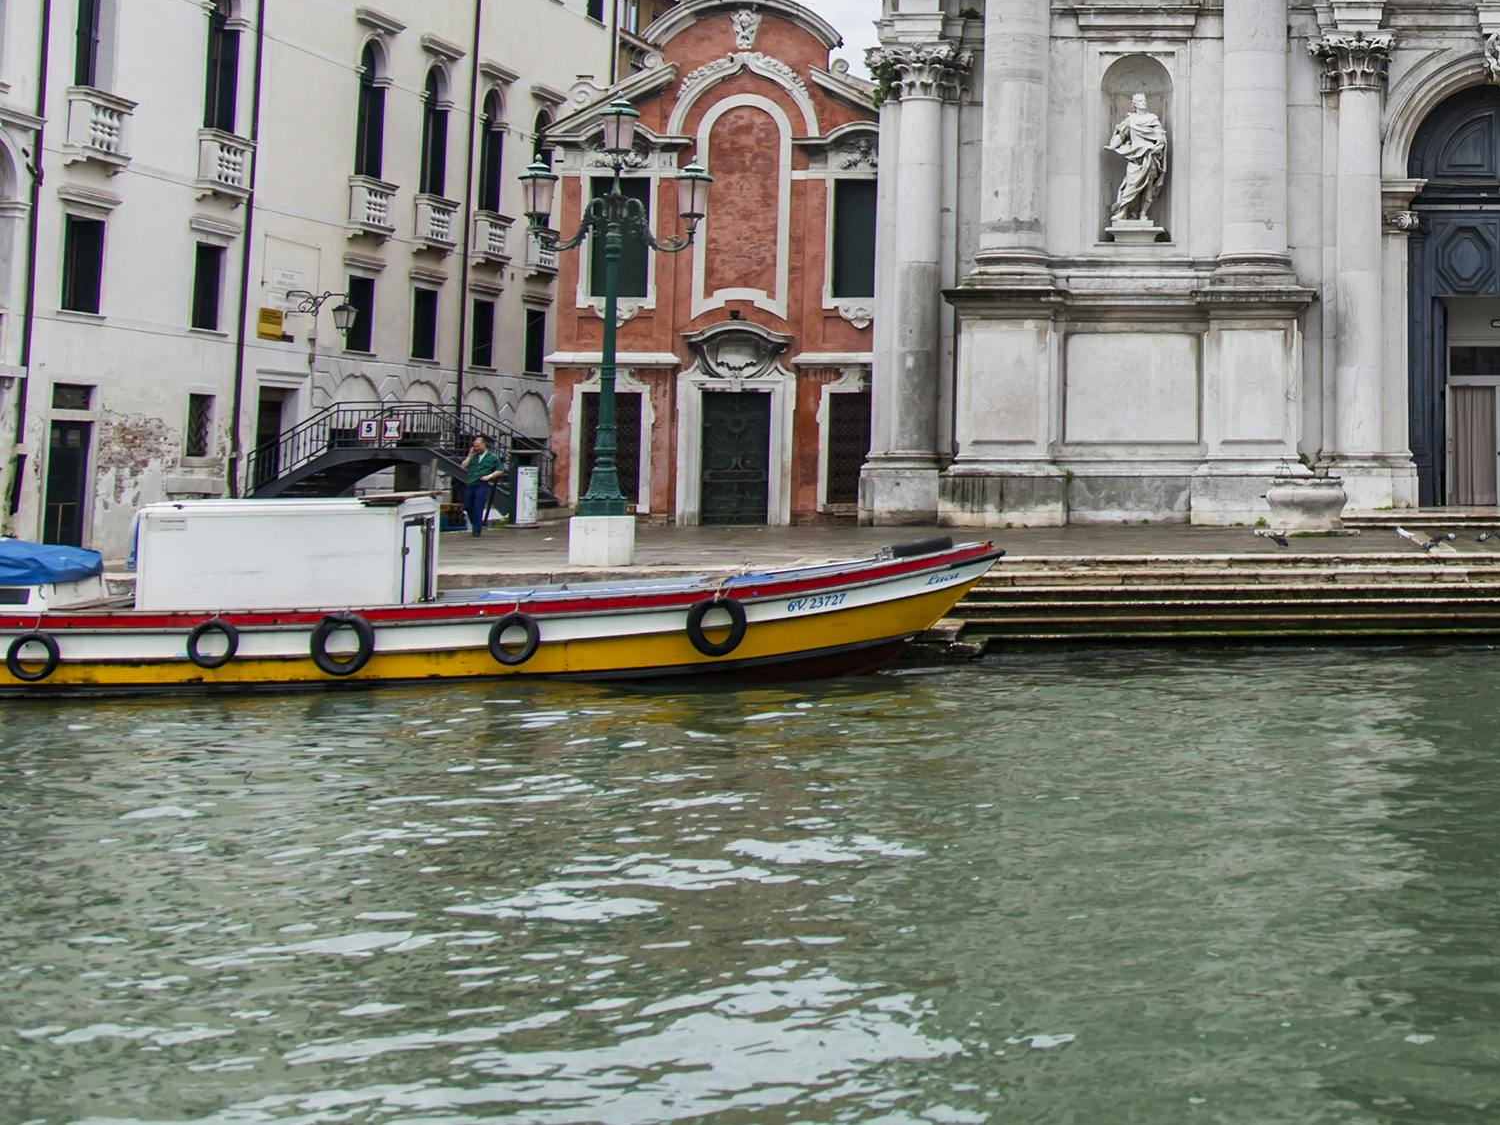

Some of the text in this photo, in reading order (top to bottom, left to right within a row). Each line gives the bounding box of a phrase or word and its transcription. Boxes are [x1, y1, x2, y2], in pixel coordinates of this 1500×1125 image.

[365, 424, 373, 432] 5
[925, 572, 960, 586] Luca
[809, 593, 847, 610] 23727
